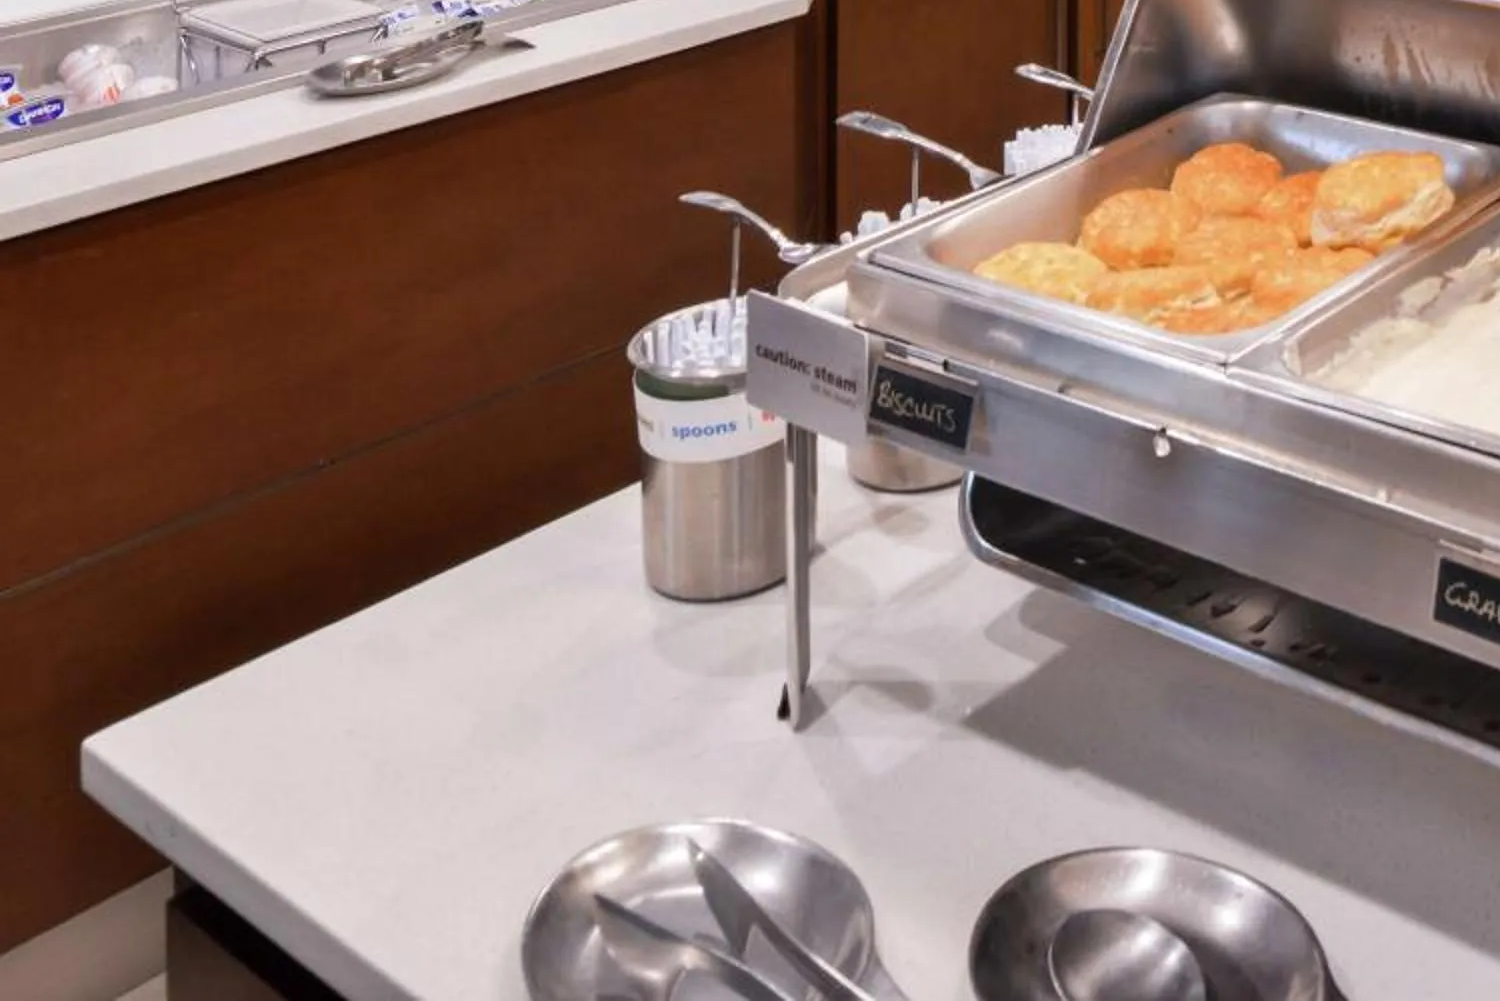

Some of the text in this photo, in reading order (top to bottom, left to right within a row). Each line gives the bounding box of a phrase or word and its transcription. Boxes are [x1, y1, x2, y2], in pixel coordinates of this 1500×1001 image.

[755, 344, 810, 375] caution:
[813, 365, 857, 394] steam
[671, 420, 738, 440] spoons
[877, 380, 956, 434] BISCUITS
